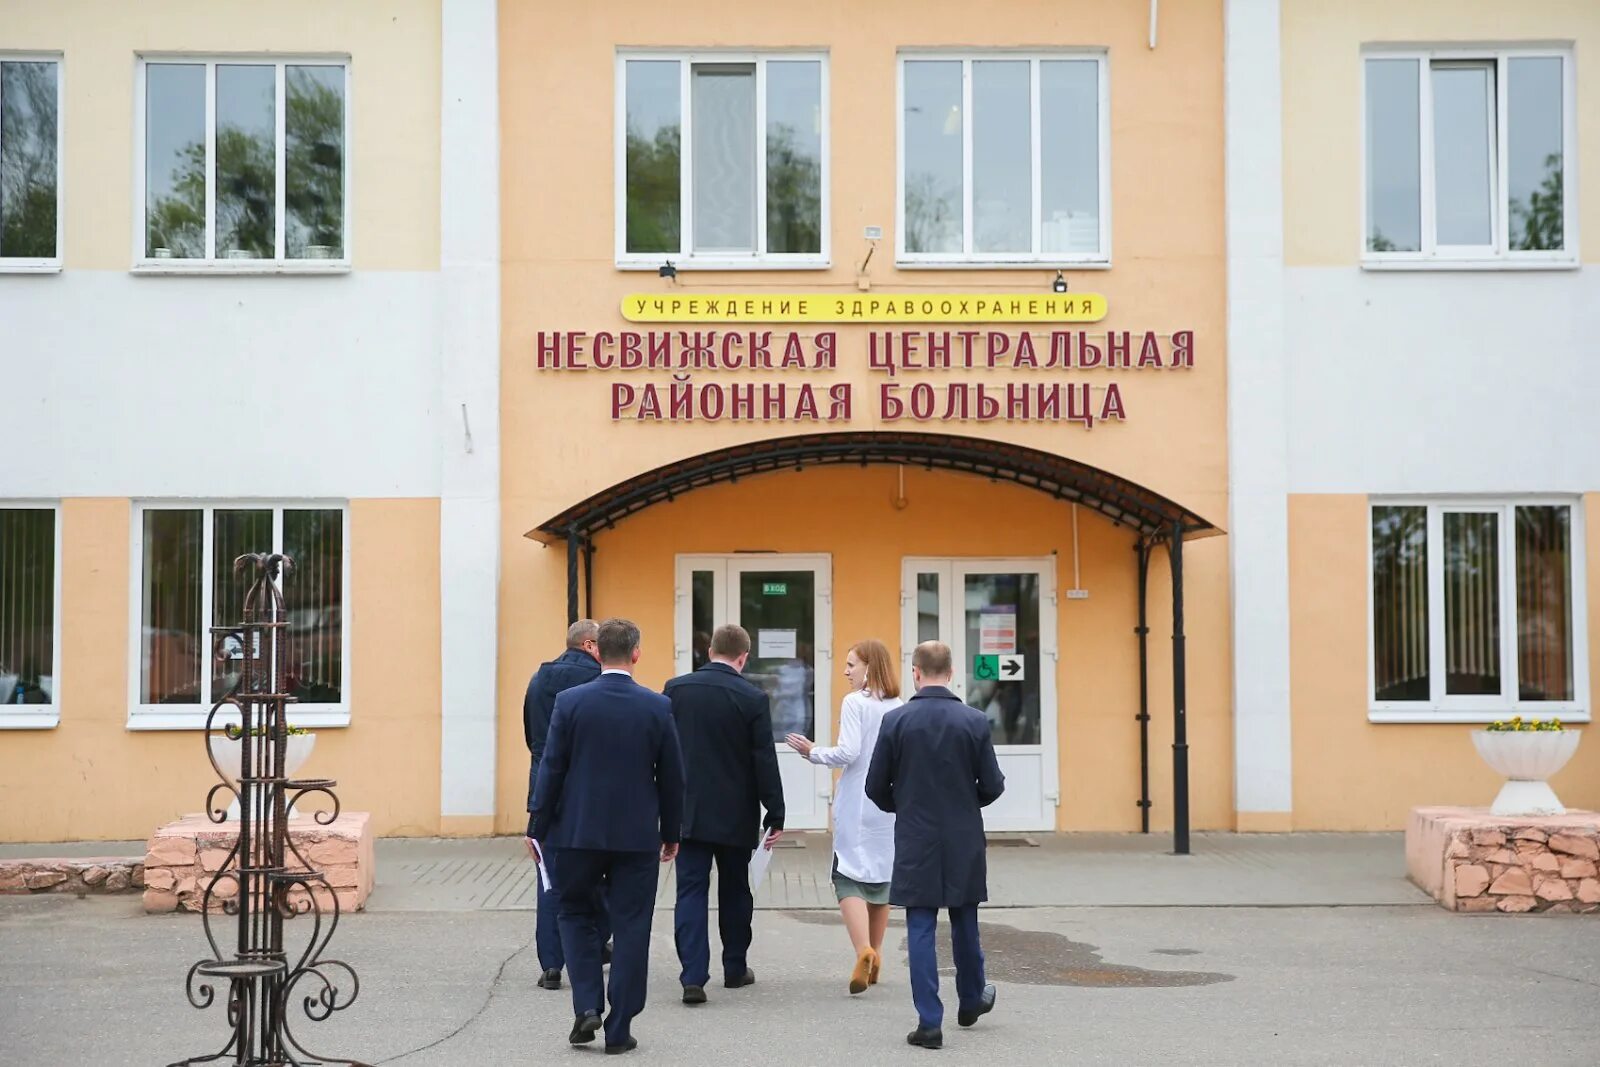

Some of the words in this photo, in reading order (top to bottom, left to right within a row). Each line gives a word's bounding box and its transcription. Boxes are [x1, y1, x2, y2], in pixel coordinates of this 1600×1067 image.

[637, 300, 808, 315] УЧРЕЖДЕНИЕ
[835, 300, 1093, 316] ЗДРАВООХРАНЕНИЯ
[536, 330, 837, 371] НЕСВИЖСКАЯ
[868, 330, 1194, 377] ЦЕНТРАЛЬНАЯ
[611, 374, 852, 420] РАЙОННАЯ
[880, 382, 1127, 429] БОЛЬНИЦА
[764, 584, 786, 593] ВХОД
